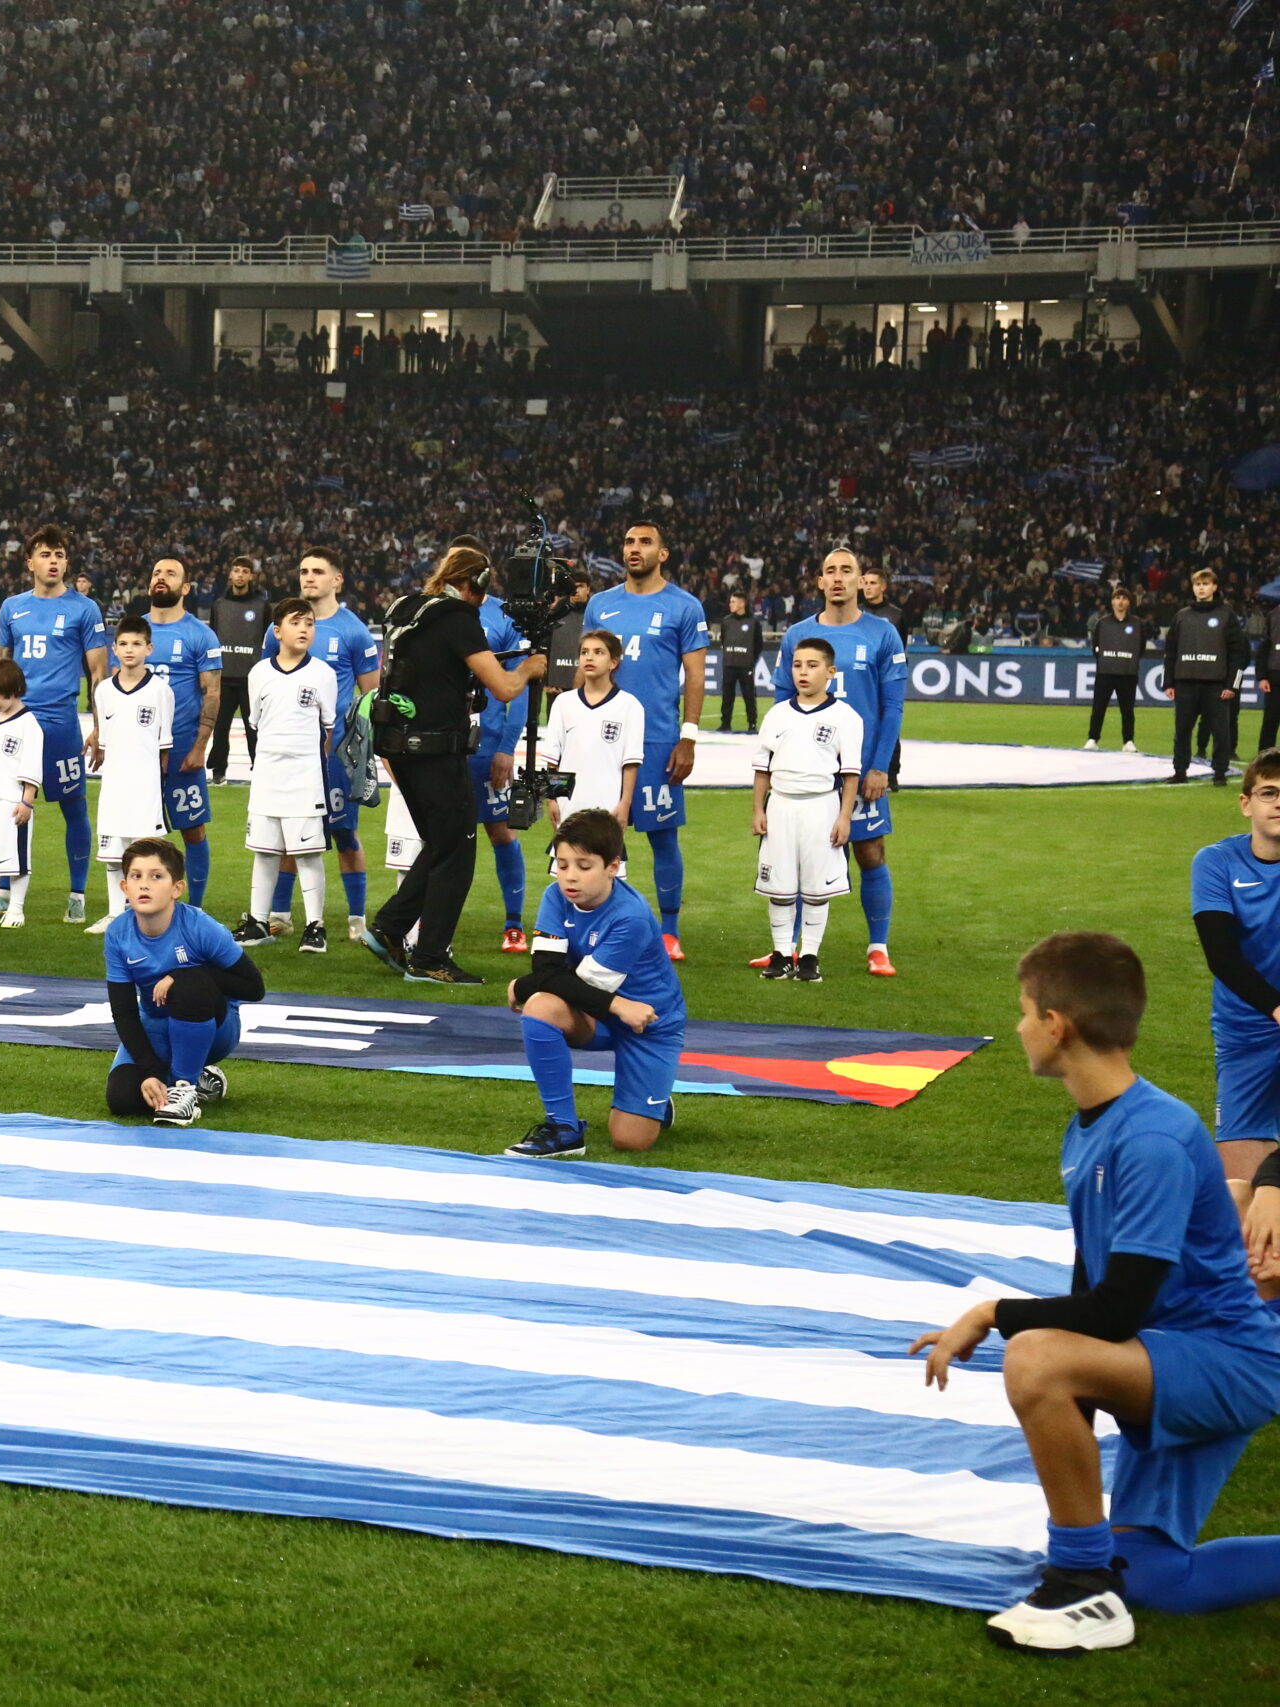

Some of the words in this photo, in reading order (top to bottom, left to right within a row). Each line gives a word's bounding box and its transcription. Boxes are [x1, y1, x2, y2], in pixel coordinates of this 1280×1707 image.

[607, 201, 625, 227] 8
[21, 634, 47, 659] 15
[234, 645, 254, 655] CREW
[1118, 651, 1133, 659] CREW
[1197, 654, 1218, 663] CREW
[556, 658, 573, 667] BALL
[55, 756, 81, 783] 15
[172, 784, 203, 812] 23
[642, 783, 673, 811] 14
